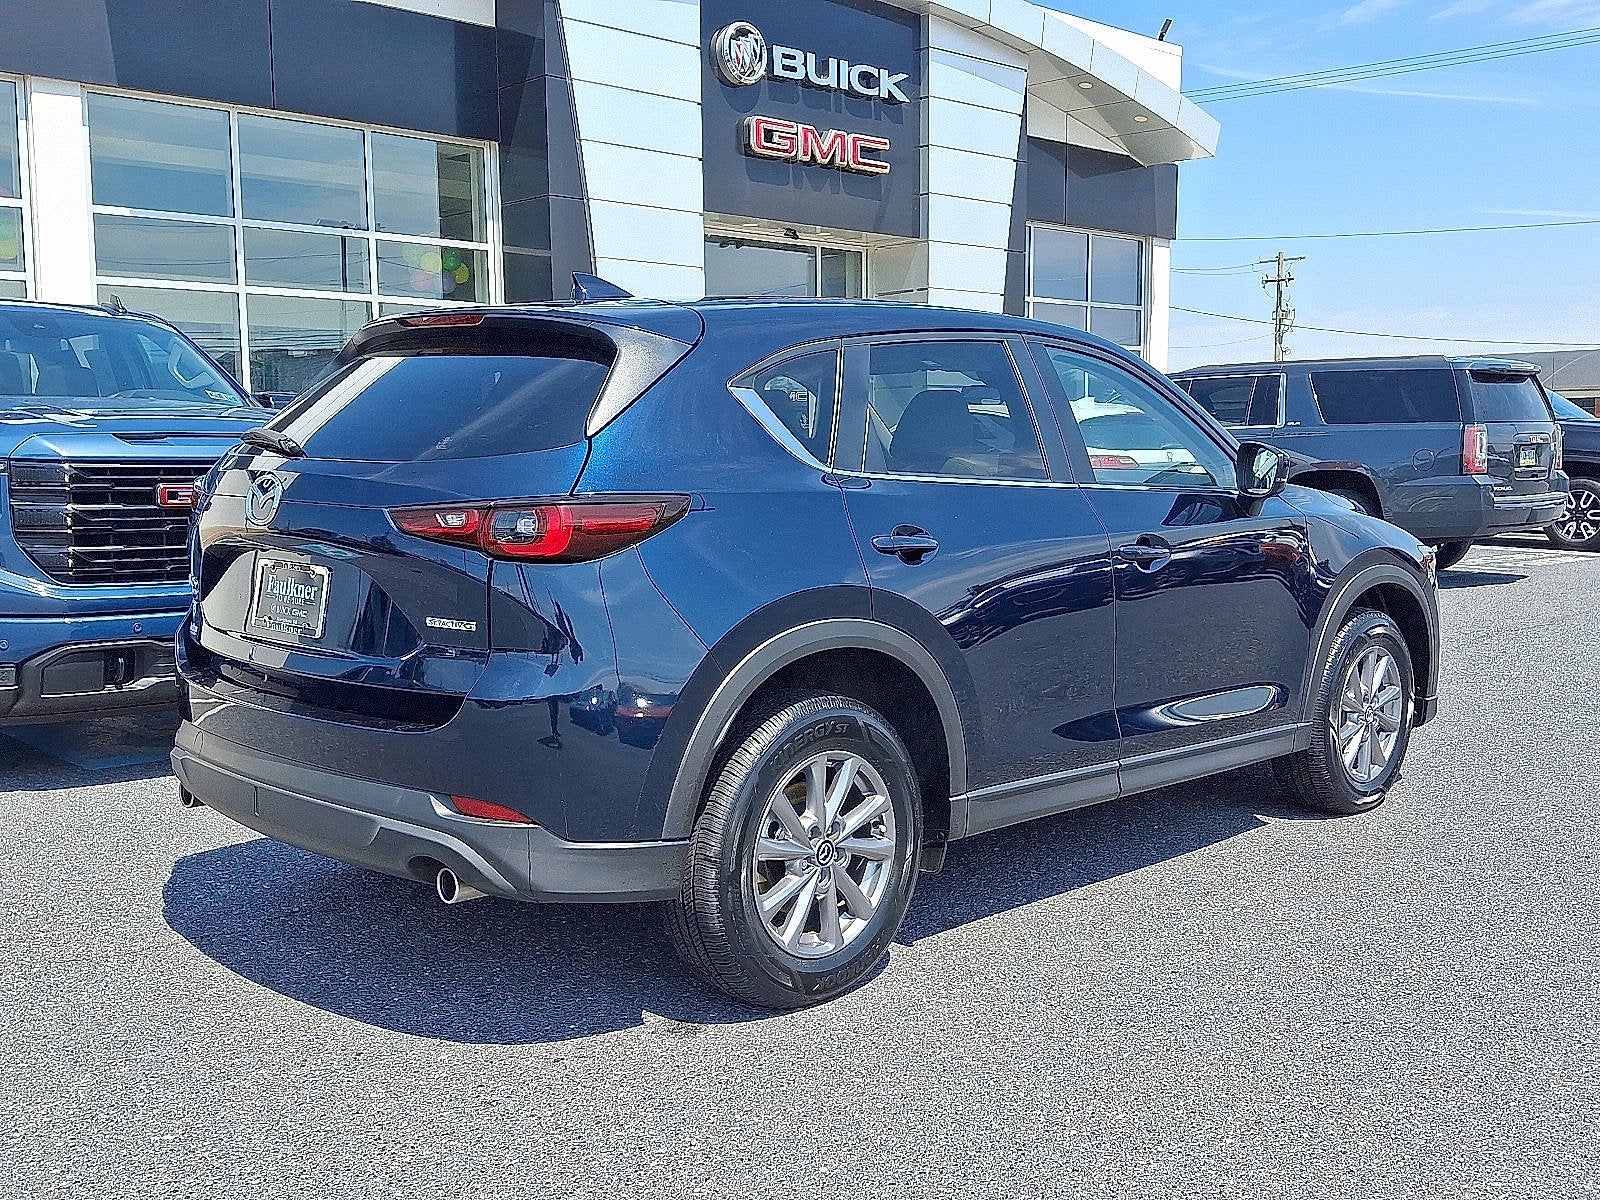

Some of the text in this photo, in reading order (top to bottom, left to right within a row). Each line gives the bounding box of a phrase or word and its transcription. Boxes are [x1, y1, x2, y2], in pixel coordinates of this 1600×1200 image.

[772, 44, 911, 103] BUICK
[745, 114, 891, 175] GMC
[266, 574, 318, 601] Faulkner
